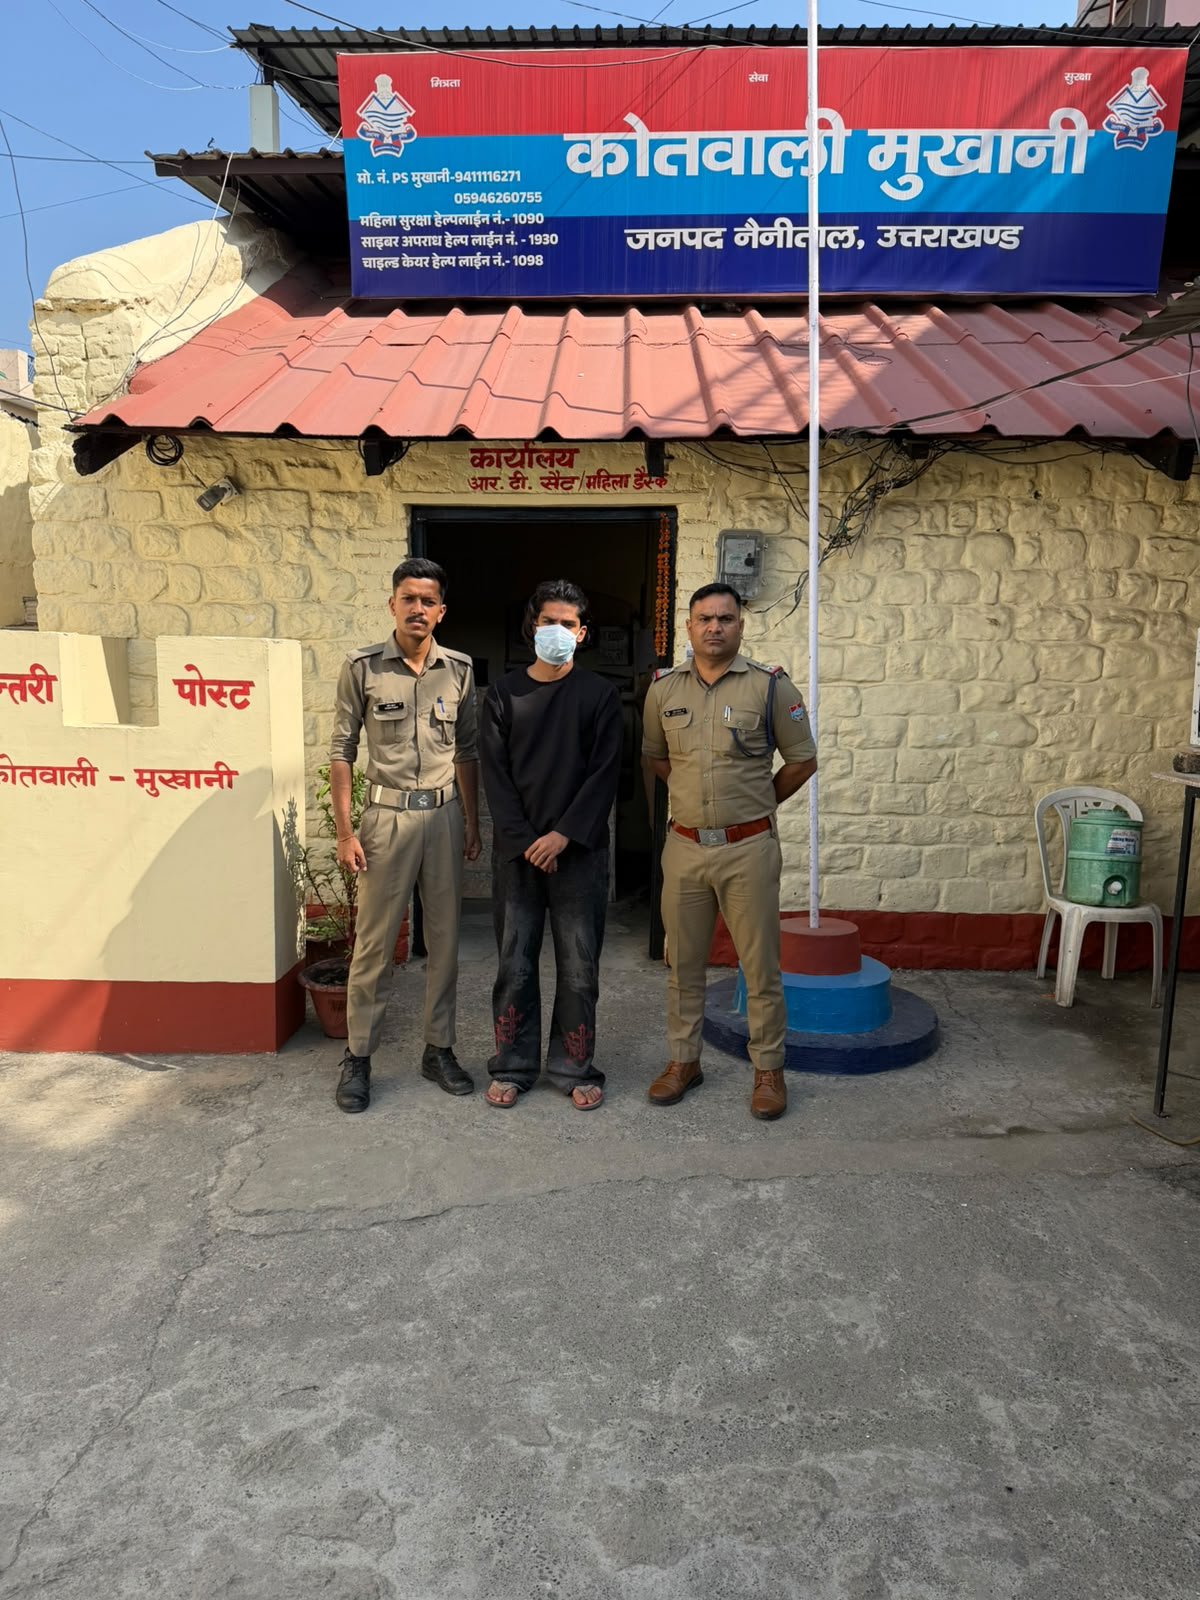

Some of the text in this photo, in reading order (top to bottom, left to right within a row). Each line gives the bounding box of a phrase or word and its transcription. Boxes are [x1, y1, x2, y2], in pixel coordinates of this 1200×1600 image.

[430, 76, 461, 88] मित्रता
[748, 71, 769, 83] सेवा
[1064, 72, 1092, 86] सुरक्षा
[563, 107, 1095, 201] कोतवाली मुखानी
[356, 169, 375, 185] मो.
[376, 169, 390, 184] नं.
[392, 172, 408, 184] PS
[454, 191, 543, 205] 05946260755
[359, 211, 397, 228] महिला
[399, 214, 432, 231] सुरक्षा
[512, 212, 544, 225] 1090
[360, 235, 399, 251] साइबर
[401, 235, 442, 248] अपराध
[444, 231, 469, 248] हेल्प
[471, 230, 503, 249] लाईन
[505, 231, 518, 246] नं.
[528, 233, 559, 245] 1930
[624, 217, 1024, 250] जनपद नैनीताल, उत्तराखण्ड
[361, 256, 400, 271] चाइल्ड
[401, 253, 430, 268] केयर
[432, 253, 456, 269] हेल्प
[458, 252, 491, 270] लाईन
[512, 254, 544, 267] 1098
[468, 441, 580, 469] कार्यालय
[467, 475, 504, 491] आर.
[508, 470, 532, 490] टी.
[0, 663, 255, 711] न्तरी पोस्ट
[133, 761, 239, 797] मुखानी
